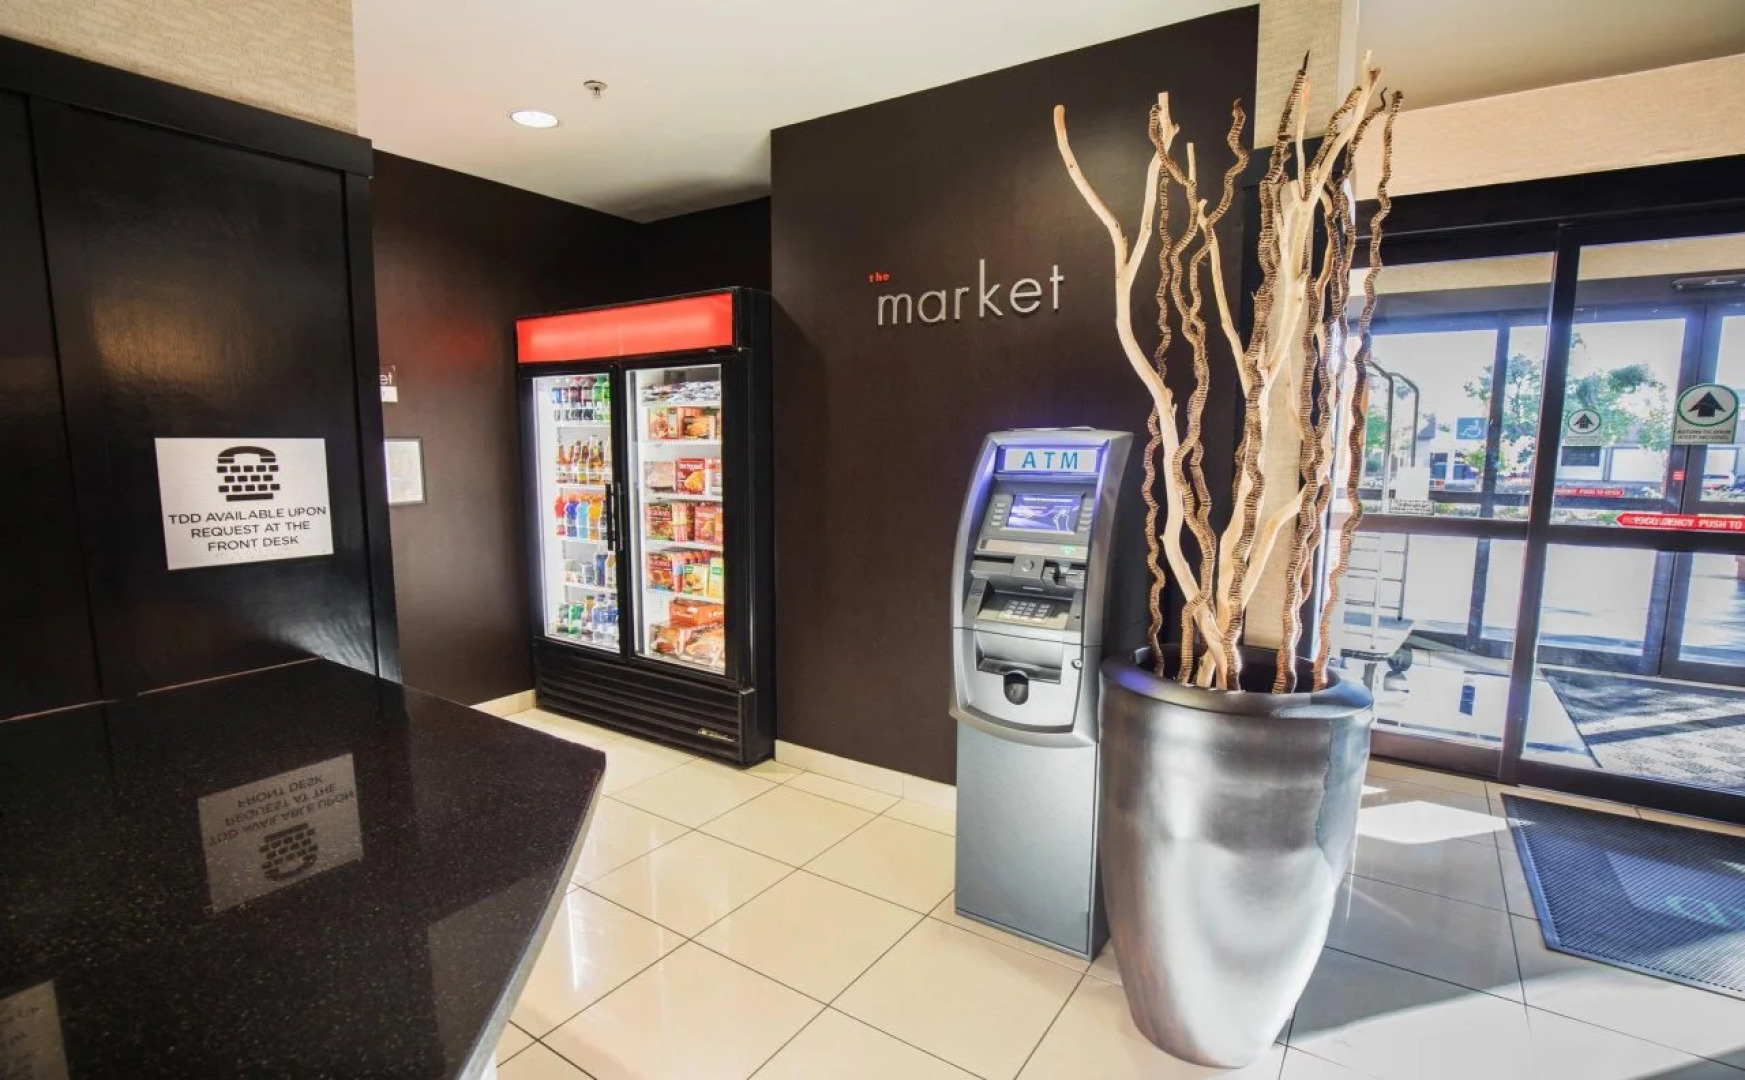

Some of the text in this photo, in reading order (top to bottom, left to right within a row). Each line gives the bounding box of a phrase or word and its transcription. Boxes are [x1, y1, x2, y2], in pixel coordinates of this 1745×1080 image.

[867, 272, 890, 283] the
[877, 259, 1064, 326] market
[1021, 450, 1078, 470] ATM
[168, 506, 327, 525] TDD AVAILABLE UPON
[1698, 519, 1727, 529] PUSH
[1728, 520, 1743, 530] TO
[190, 520, 311, 539] REQUEST AT THE
[207, 535, 299, 551] FRONT DESK
